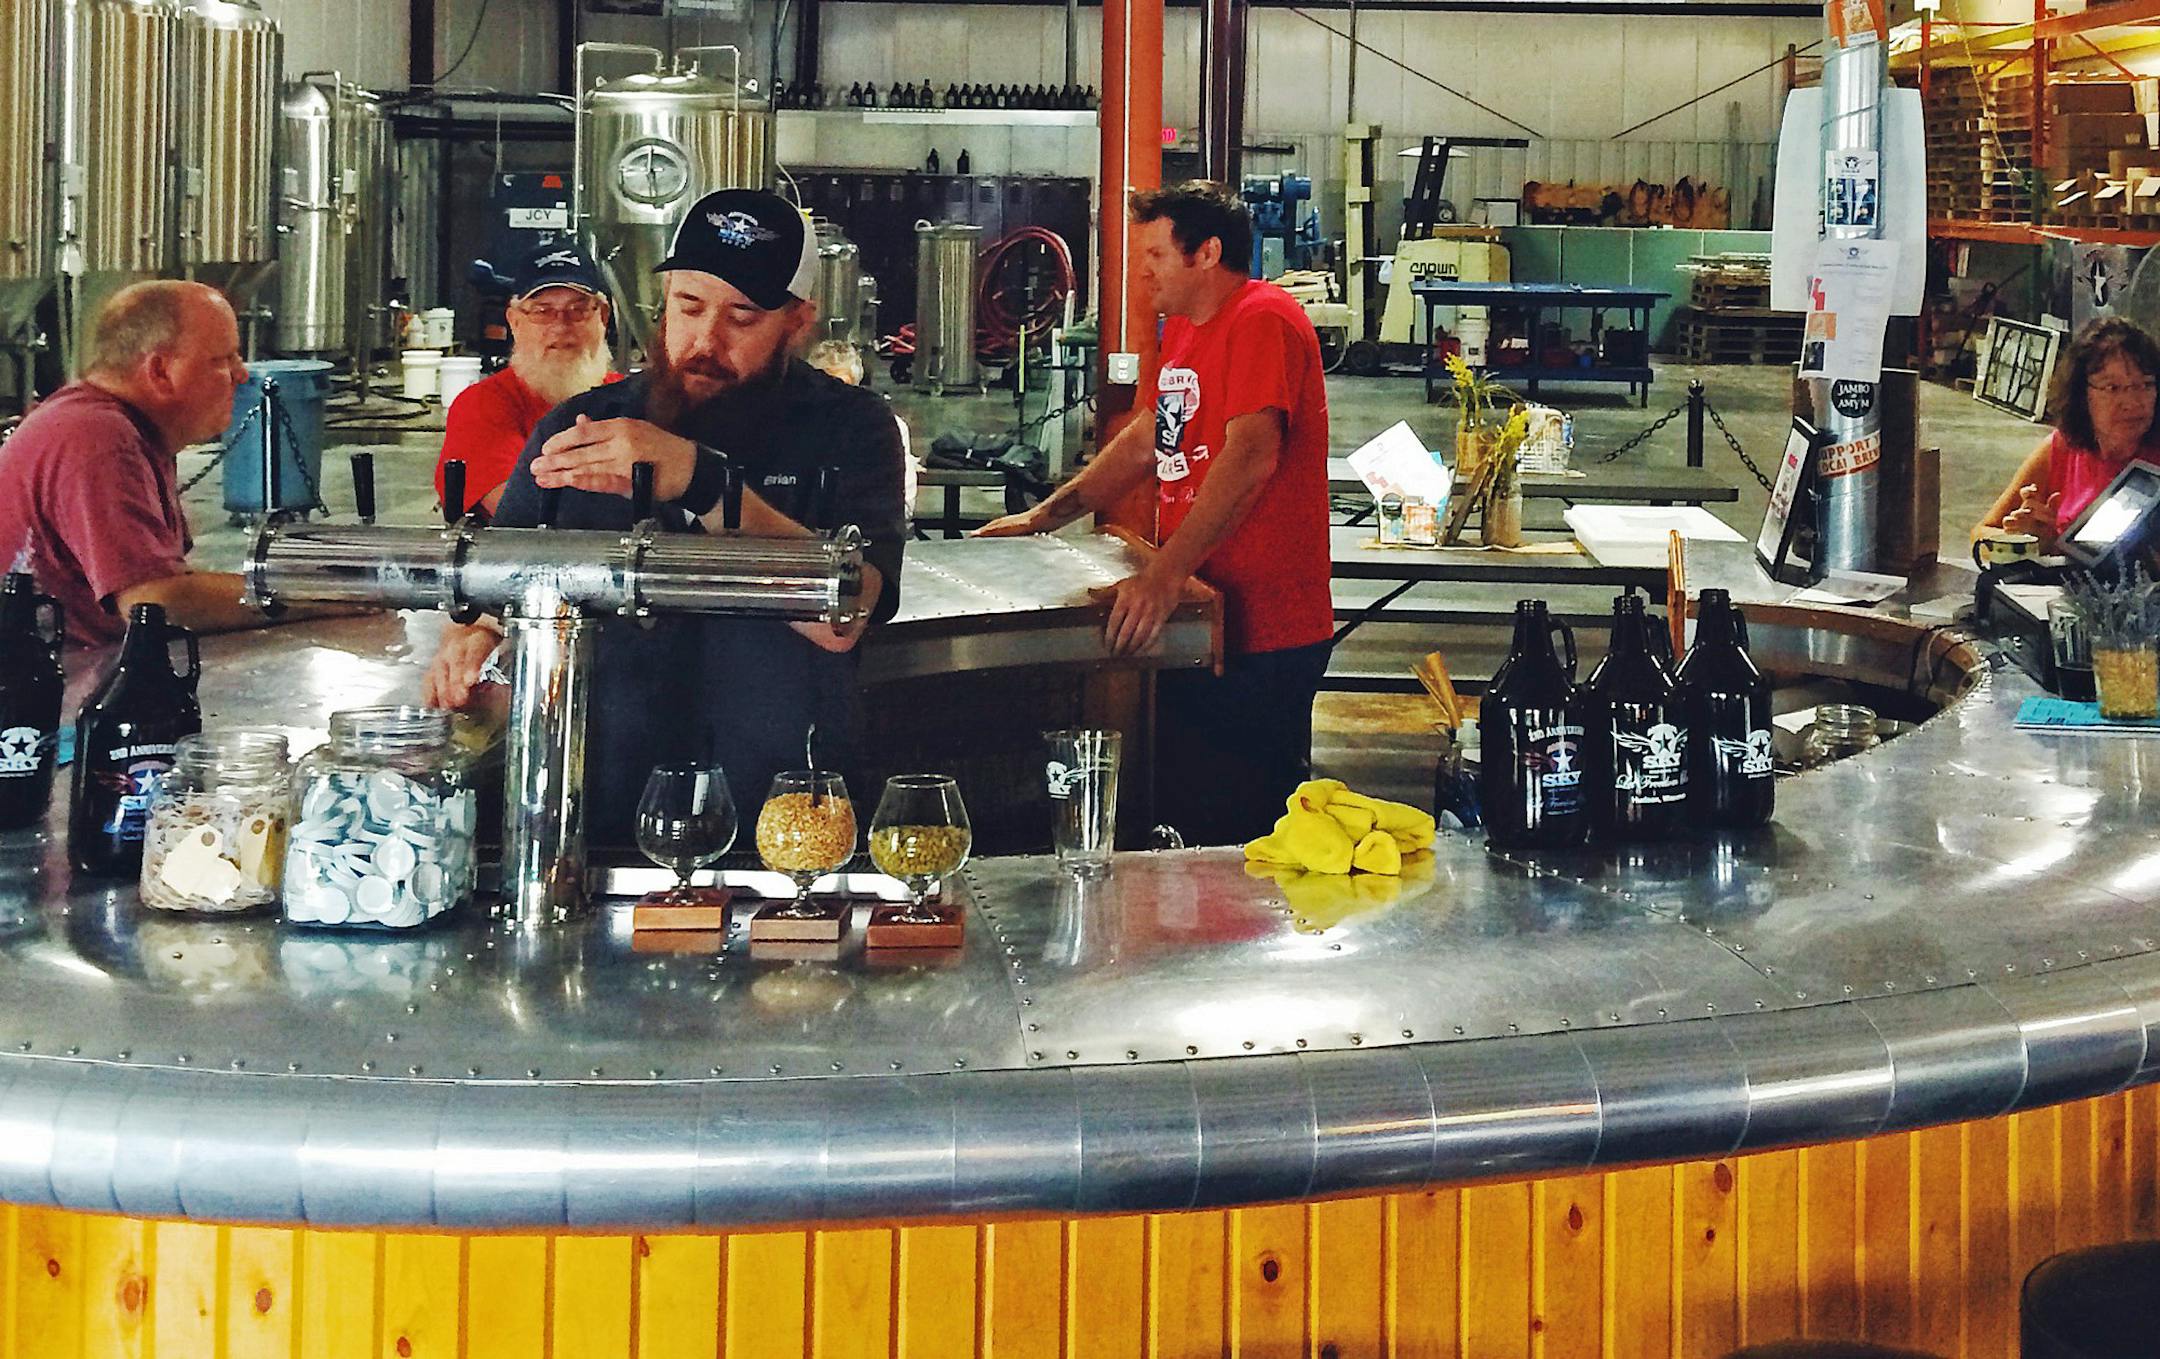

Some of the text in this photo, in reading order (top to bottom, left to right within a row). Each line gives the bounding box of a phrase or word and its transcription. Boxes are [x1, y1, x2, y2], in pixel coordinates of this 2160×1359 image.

[1818, 459, 1847, 474] OCAL
[763, 474, 797, 486] Brian
[1542, 770, 1582, 788] SKY
